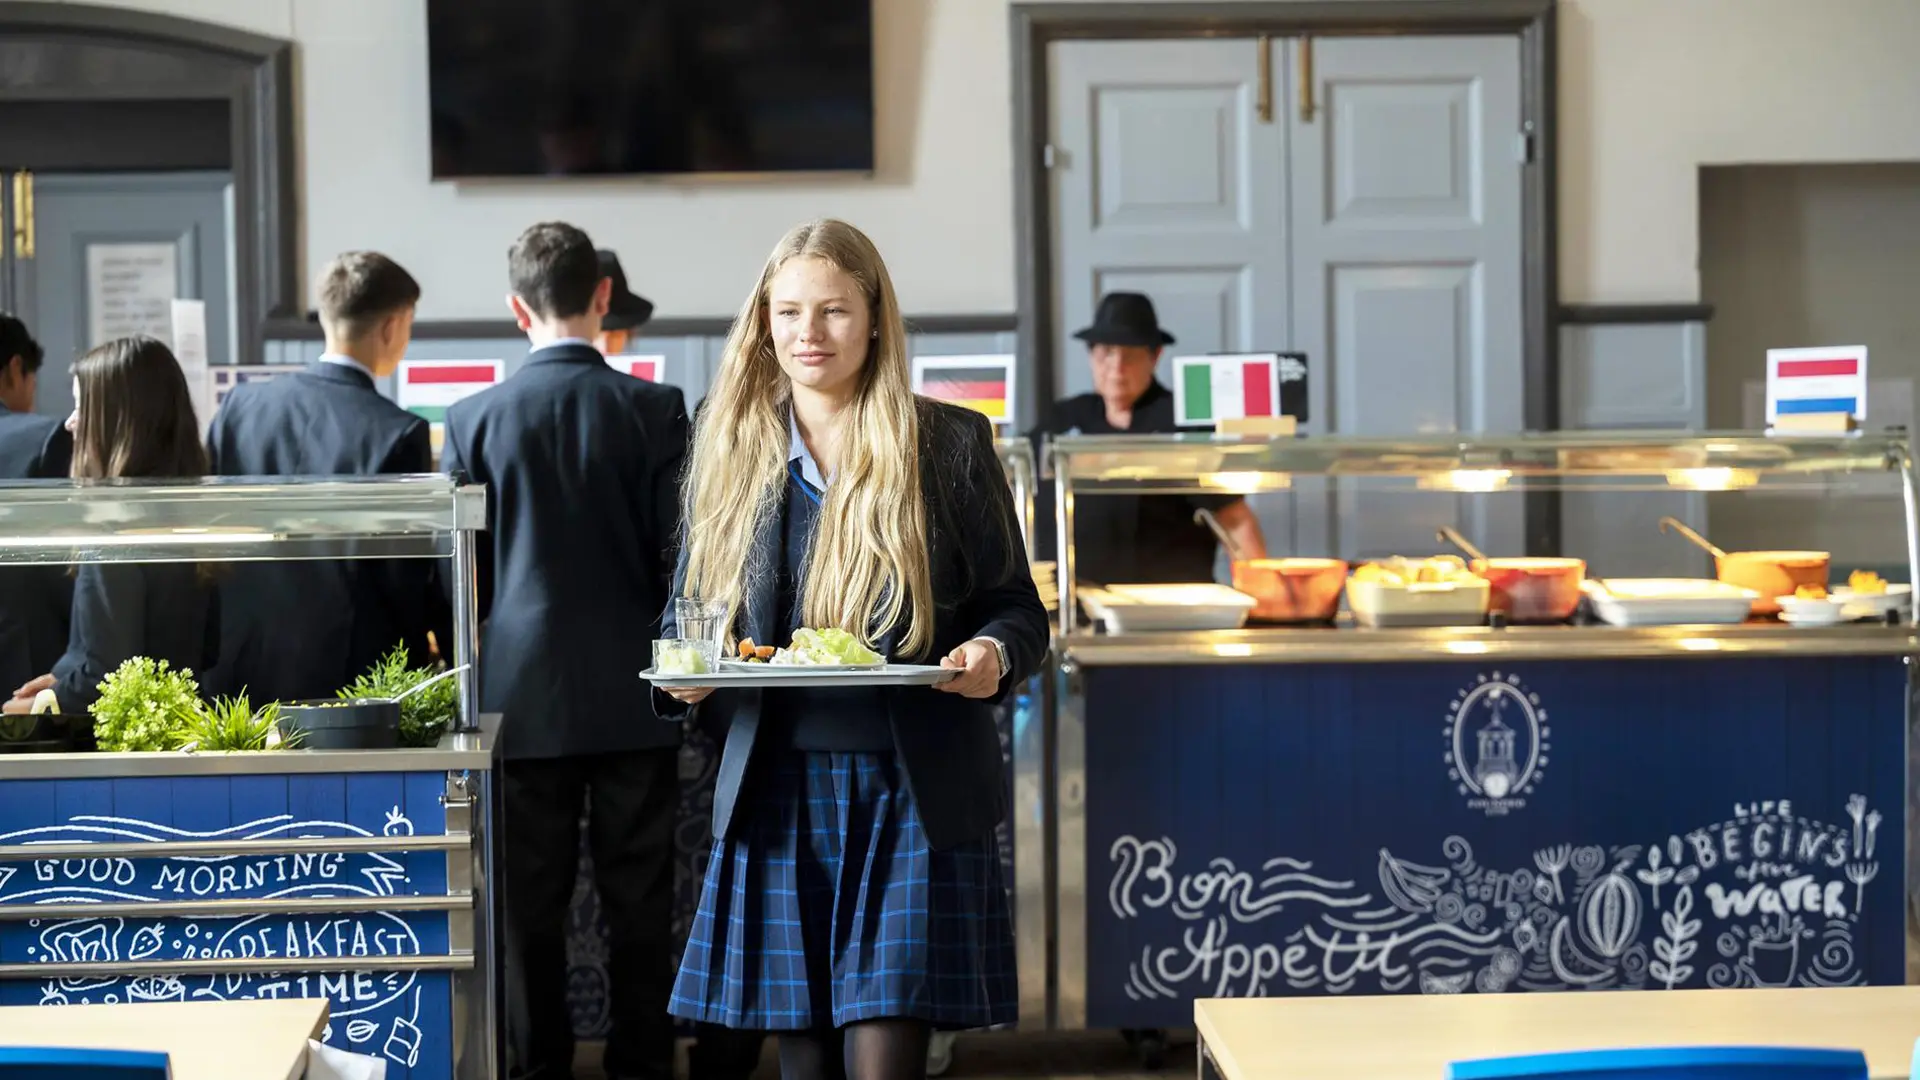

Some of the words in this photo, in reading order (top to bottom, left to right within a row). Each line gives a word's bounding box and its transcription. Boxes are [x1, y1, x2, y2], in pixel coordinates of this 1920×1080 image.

[1734, 799, 1792, 817] LIFE
[1691, 822, 1848, 869] BEGINS
[35, 857, 136, 886] GOOD
[151, 852, 347, 895] MORNING
[1110, 834, 1282, 919] Bon
[256, 970, 379, 1003] TIME
